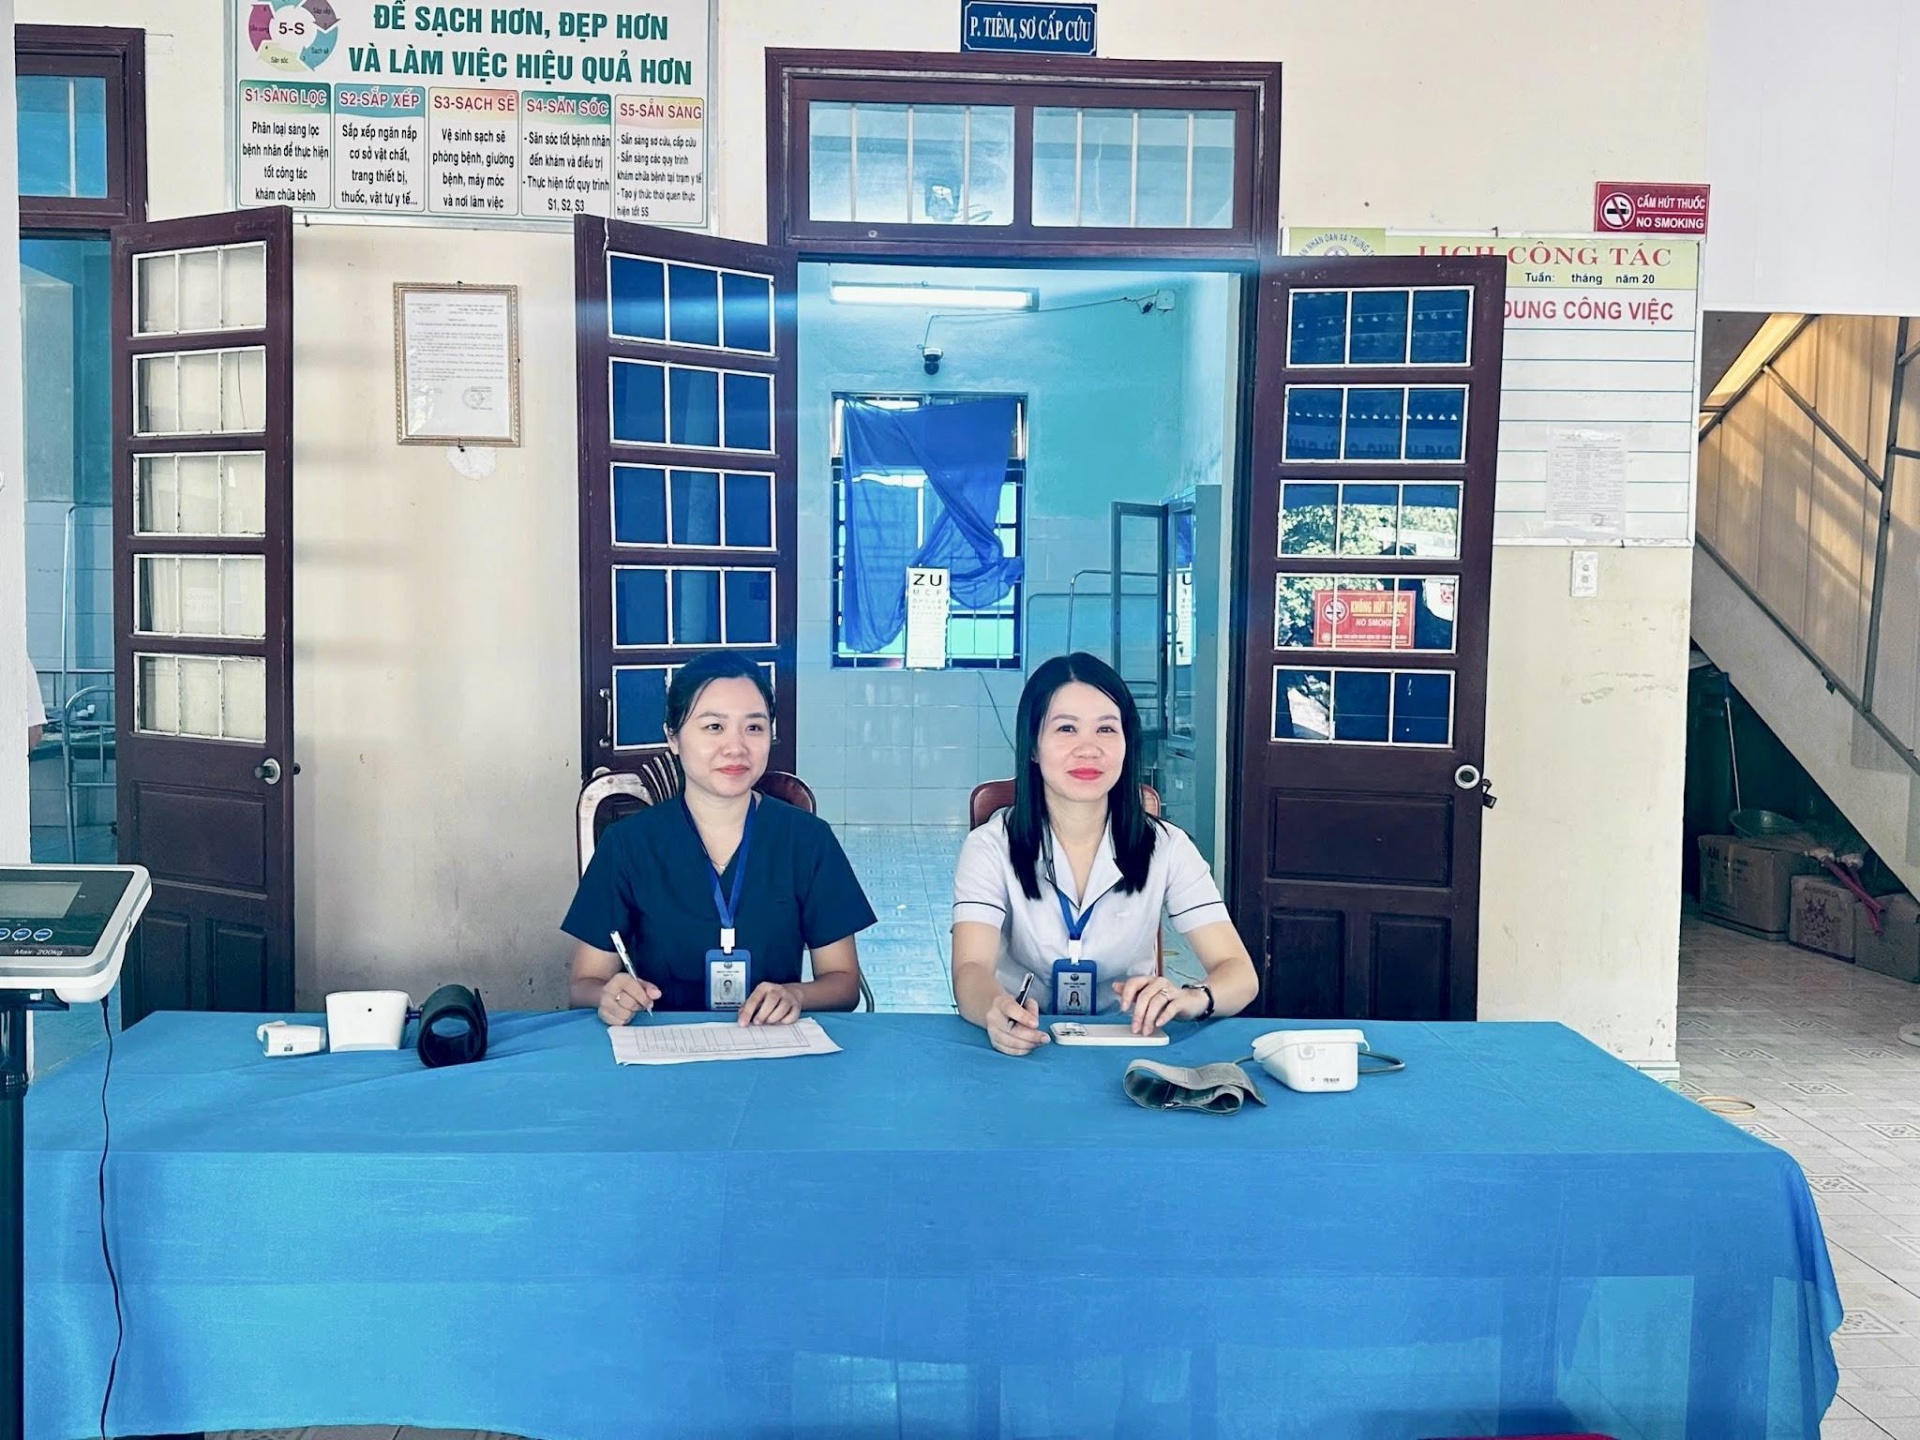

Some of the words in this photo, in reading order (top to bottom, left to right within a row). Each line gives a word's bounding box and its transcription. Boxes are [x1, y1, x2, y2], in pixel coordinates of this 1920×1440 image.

[279, 22, 305, 35] 5-S
[415, 6, 482, 37] SẠCH
[491, 8, 550, 38] HƠN,
[559, 12, 607, 42] ĐẸP
[616, 13, 668, 40] HƠN
[969, 16, 981, 37] P.
[983, 11, 1018, 42] TIÊM,
[1020, 16, 1036, 40] SƠ
[1038, 10, 1063, 40] CẤP
[1065, 15, 1091, 42] CỨU
[349, 42, 381, 72] VÀ
[389, 44, 443, 74] LÀM
[452, 47, 507, 82] VIỆC
[516, 50, 573, 84] HIỆU
[582, 49, 632, 84] QUẢ
[641, 58, 692, 85] HƠN
[245, 84, 297, 103] S1-SÀNG
[302, 90, 326, 107] LỌC
[392, 88, 419, 107] XẾP
[434, 96, 492, 112] S3-SẠCH
[252, 122, 271, 134] Phân
[273, 122, 286, 137] loại
[288, 123, 306, 138] sàng
[309, 124, 319, 138] lọc
[454, 129, 472, 141] sinh
[474, 130, 493, 144] sạch
[560, 132, 570, 145] tốt
[572, 134, 590, 148] bệnh
[243, 143, 261, 158] bệnh
[263, 144, 281, 156] nhân
[433, 150, 458, 166] phòng
[567, 155, 575, 167] và
[264, 164, 274, 178] tốt
[276, 166, 294, 182] công
[296, 167, 307, 179] tác
[352, 170, 373, 184] trang
[468, 173, 485, 189] máy
[487, 174, 504, 186] móc
[566, 176, 575, 189] tốt
[577, 180, 591, 193] quy
[256, 187, 275, 200] khám
[297, 189, 316, 203] bệnh
[395, 195, 400, 207] y
[443, 194, 453, 206] và
[470, 196, 484, 207] làm
[487, 196, 504, 210] việc
[1637, 193, 1657, 208] CẤM
[1658, 195, 1677, 208] HÚT
[1677, 195, 1705, 209] THUỐC
[548, 198, 559, 212] S1,
[562, 199, 573, 212] S2,
[575, 200, 585, 212] S3
[1636, 217, 1652, 228] NO
[1654, 217, 1704, 229] SMOKING
[1508, 241, 1598, 267] CÔNG
[1609, 243, 1672, 267] TÁC
[1571, 273, 1602, 285] tháng
[1615, 275, 1639, 284] năm
[1642, 274, 1655, 284] 20
[1563, 297, 1621, 320] CÔNG
[1628, 298, 1673, 325] VIỆC
[1355, 618, 1367, 627] NO
